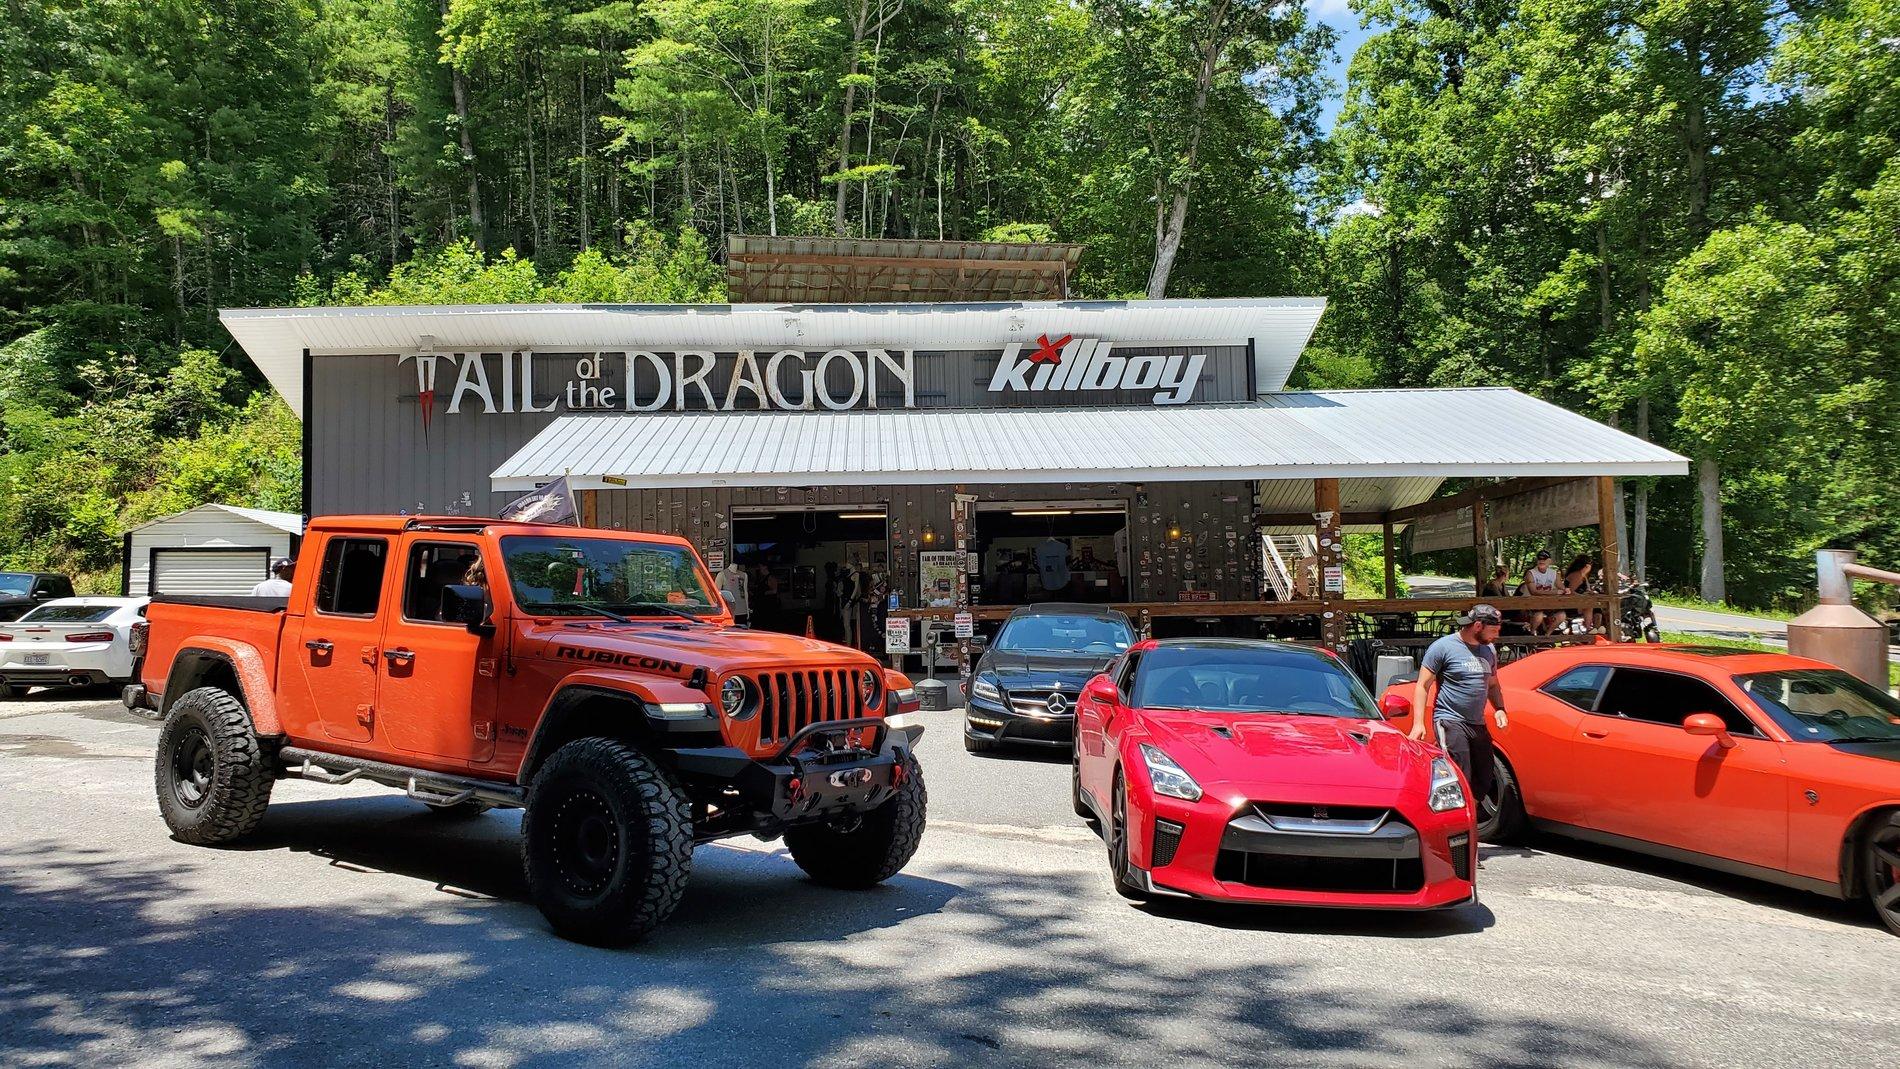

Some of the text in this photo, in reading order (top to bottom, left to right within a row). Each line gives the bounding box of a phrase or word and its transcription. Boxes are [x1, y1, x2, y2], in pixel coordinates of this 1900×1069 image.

[576, 350, 605, 379] of
[624, 349, 917, 412] DRAGON
[987, 334, 1207, 405] killboy
[397, 350, 560, 448] TAIL
[566, 380, 617, 409] the
[556, 646, 683, 671] RUBICON
